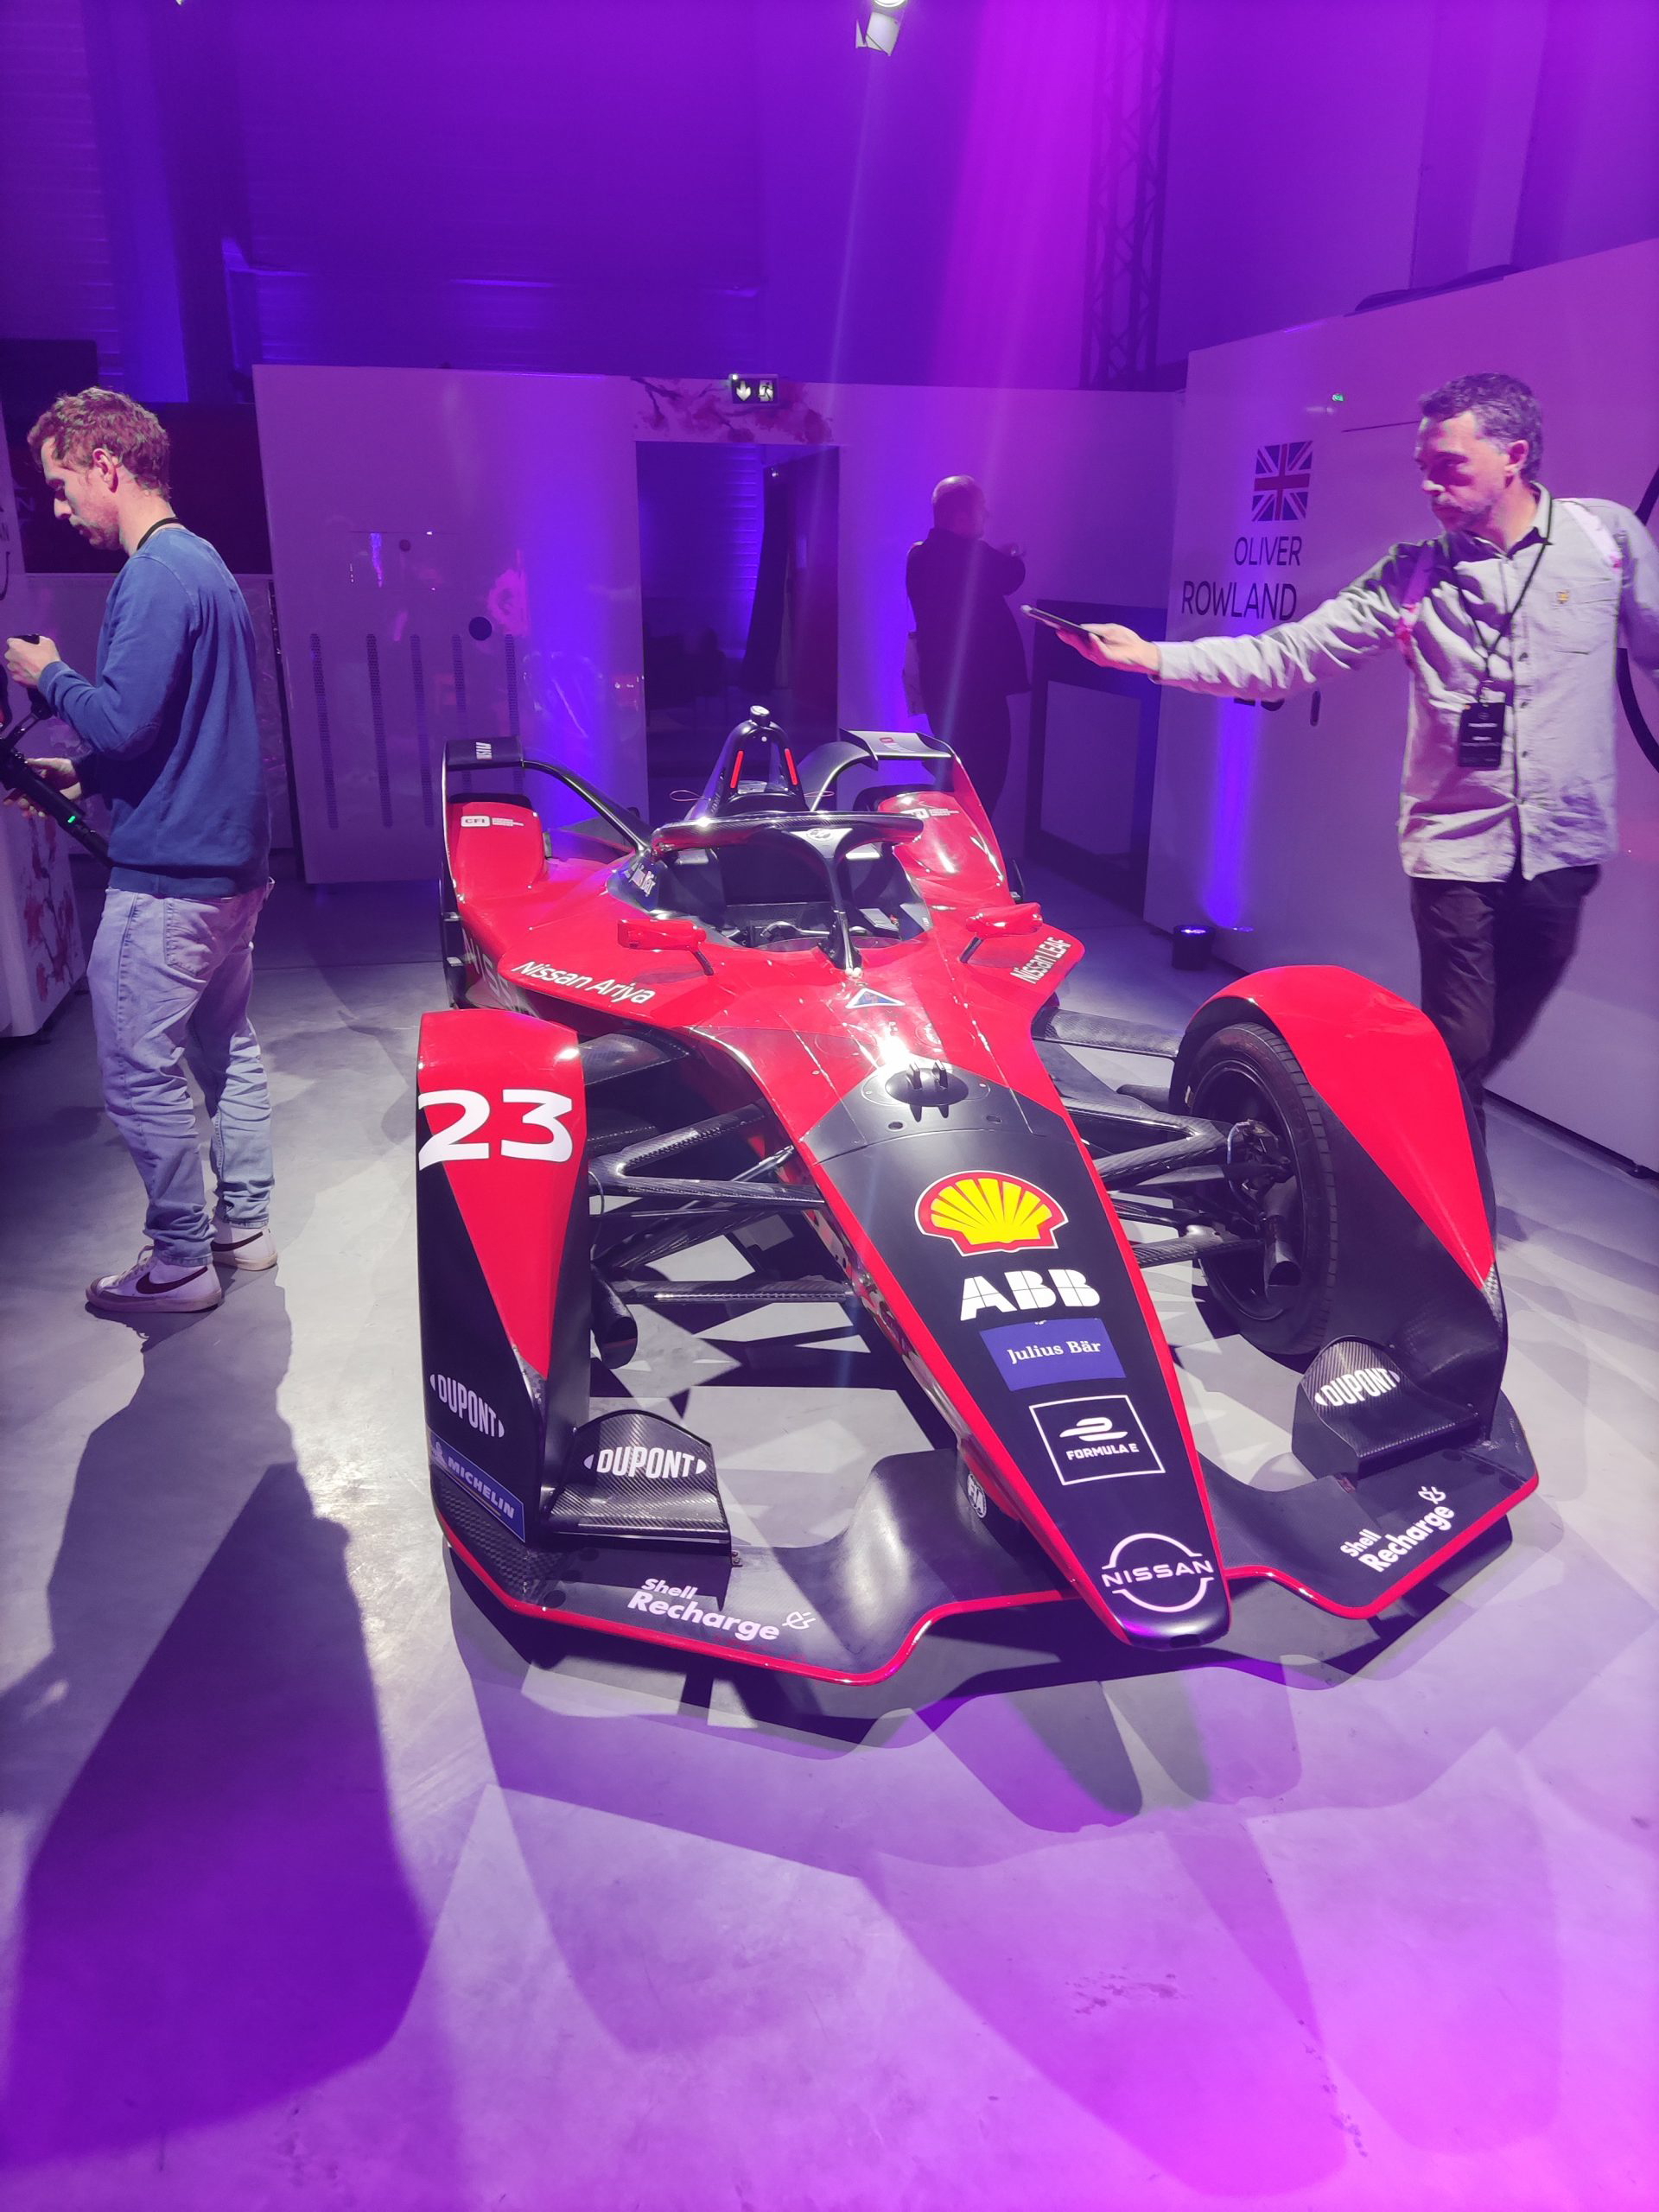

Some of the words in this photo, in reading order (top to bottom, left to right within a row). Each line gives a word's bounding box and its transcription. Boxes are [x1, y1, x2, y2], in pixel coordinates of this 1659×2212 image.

[1234, 536, 1302, 567] OLIVER
[1181, 580, 1297, 622] ROWLAND
[1010, 947, 1049, 984] Nissan
[1039, 936, 1072, 966] LEAF
[512, 961, 591, 990] Nissan
[585, 979, 656, 1005] Ariya
[418, 1089, 574, 1171] 23
[960, 1269, 1100, 1320] ABB
[1007, 1344, 1064, 1365] Julius
[1066, 1340, 1102, 1357] Bär
[437, 1374, 497, 1438] DUPONT
[1323, 1368, 1396, 1407] DUPONT
[596, 1446, 695, 1478] DUPONT
[1066, 1446, 1128, 1460] FORMULA
[1129, 1443, 1140, 1453] E
[448, 1456, 516, 1522] MICHELIN
[1340, 1528, 1381, 1559] Shell
[1359, 1505, 1453, 1572] Recharge
[641, 1578, 698, 1599] Shell
[1102, 1560, 1213, 1587] NISSAN
[627, 1592, 780, 1642] Recharge
